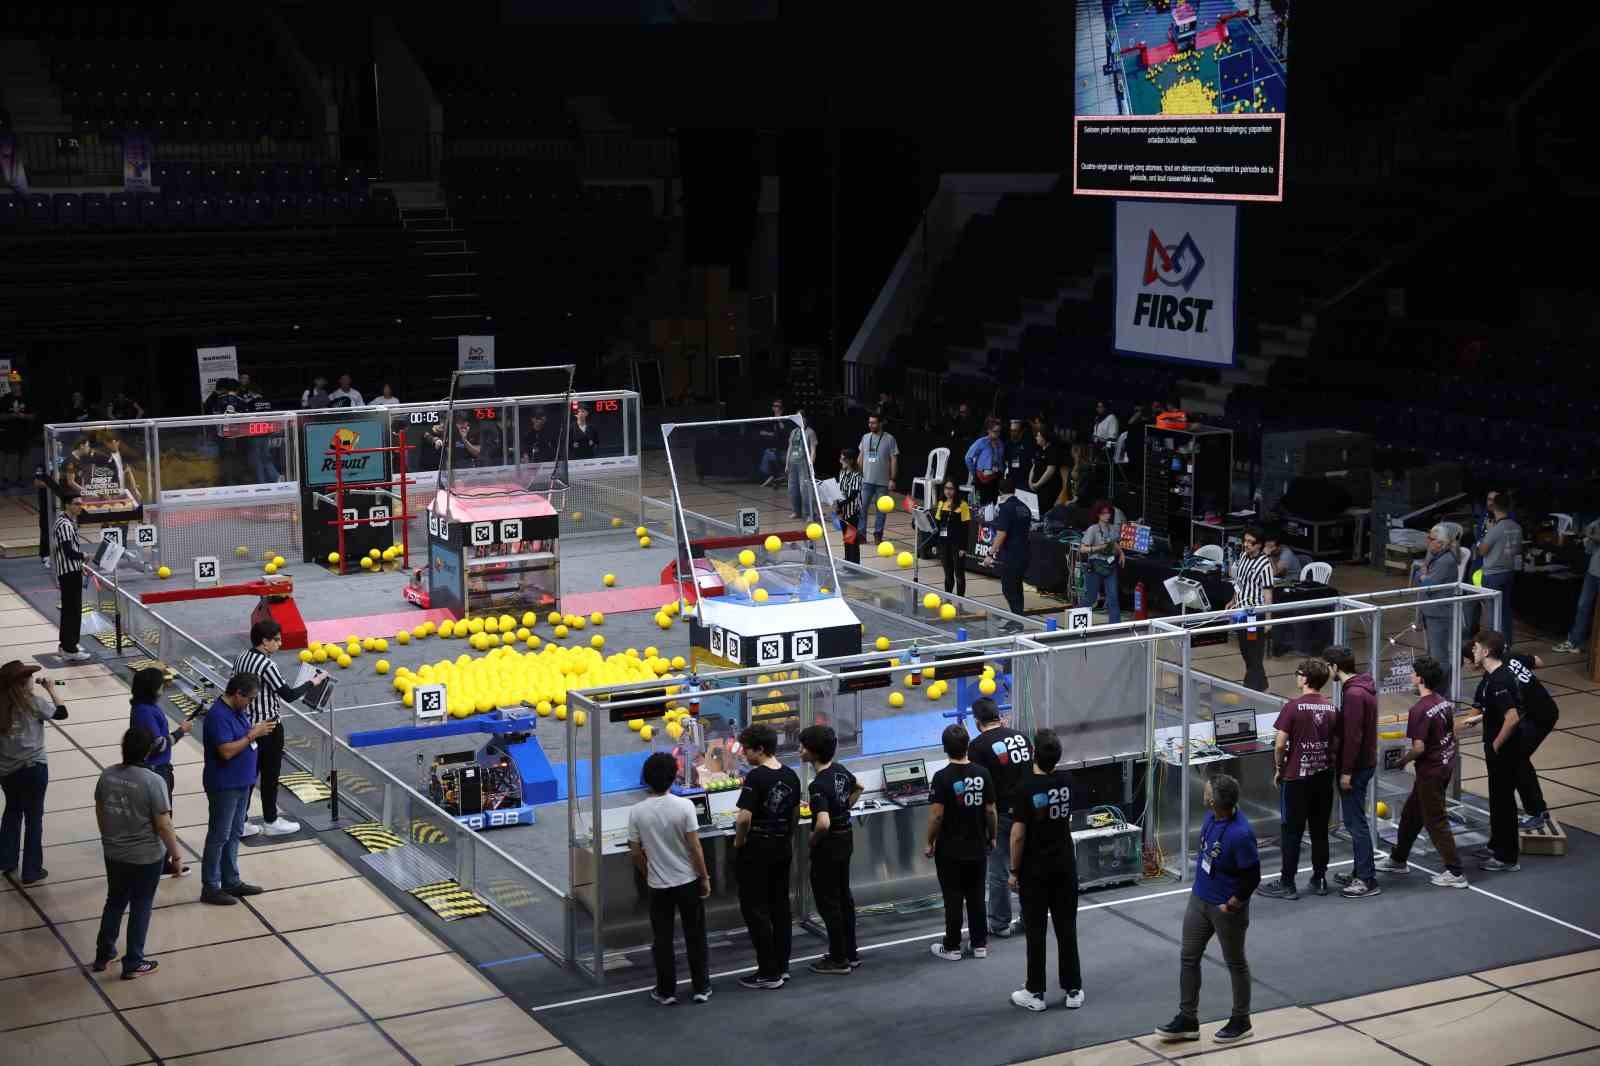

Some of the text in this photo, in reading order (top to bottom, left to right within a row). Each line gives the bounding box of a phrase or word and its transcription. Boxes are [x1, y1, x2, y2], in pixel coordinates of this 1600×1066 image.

[1133, 293, 1213, 333] FIRST
[410, 411, 439, 424] 00:05
[1004, 734, 1026, 750] 29
[1010, 747, 1030, 764] 05
[964, 776, 985, 791] 29
[964, 792, 983, 807] 05
[1047, 786, 1070, 804] 29
[1049, 802, 1070, 820] 05
